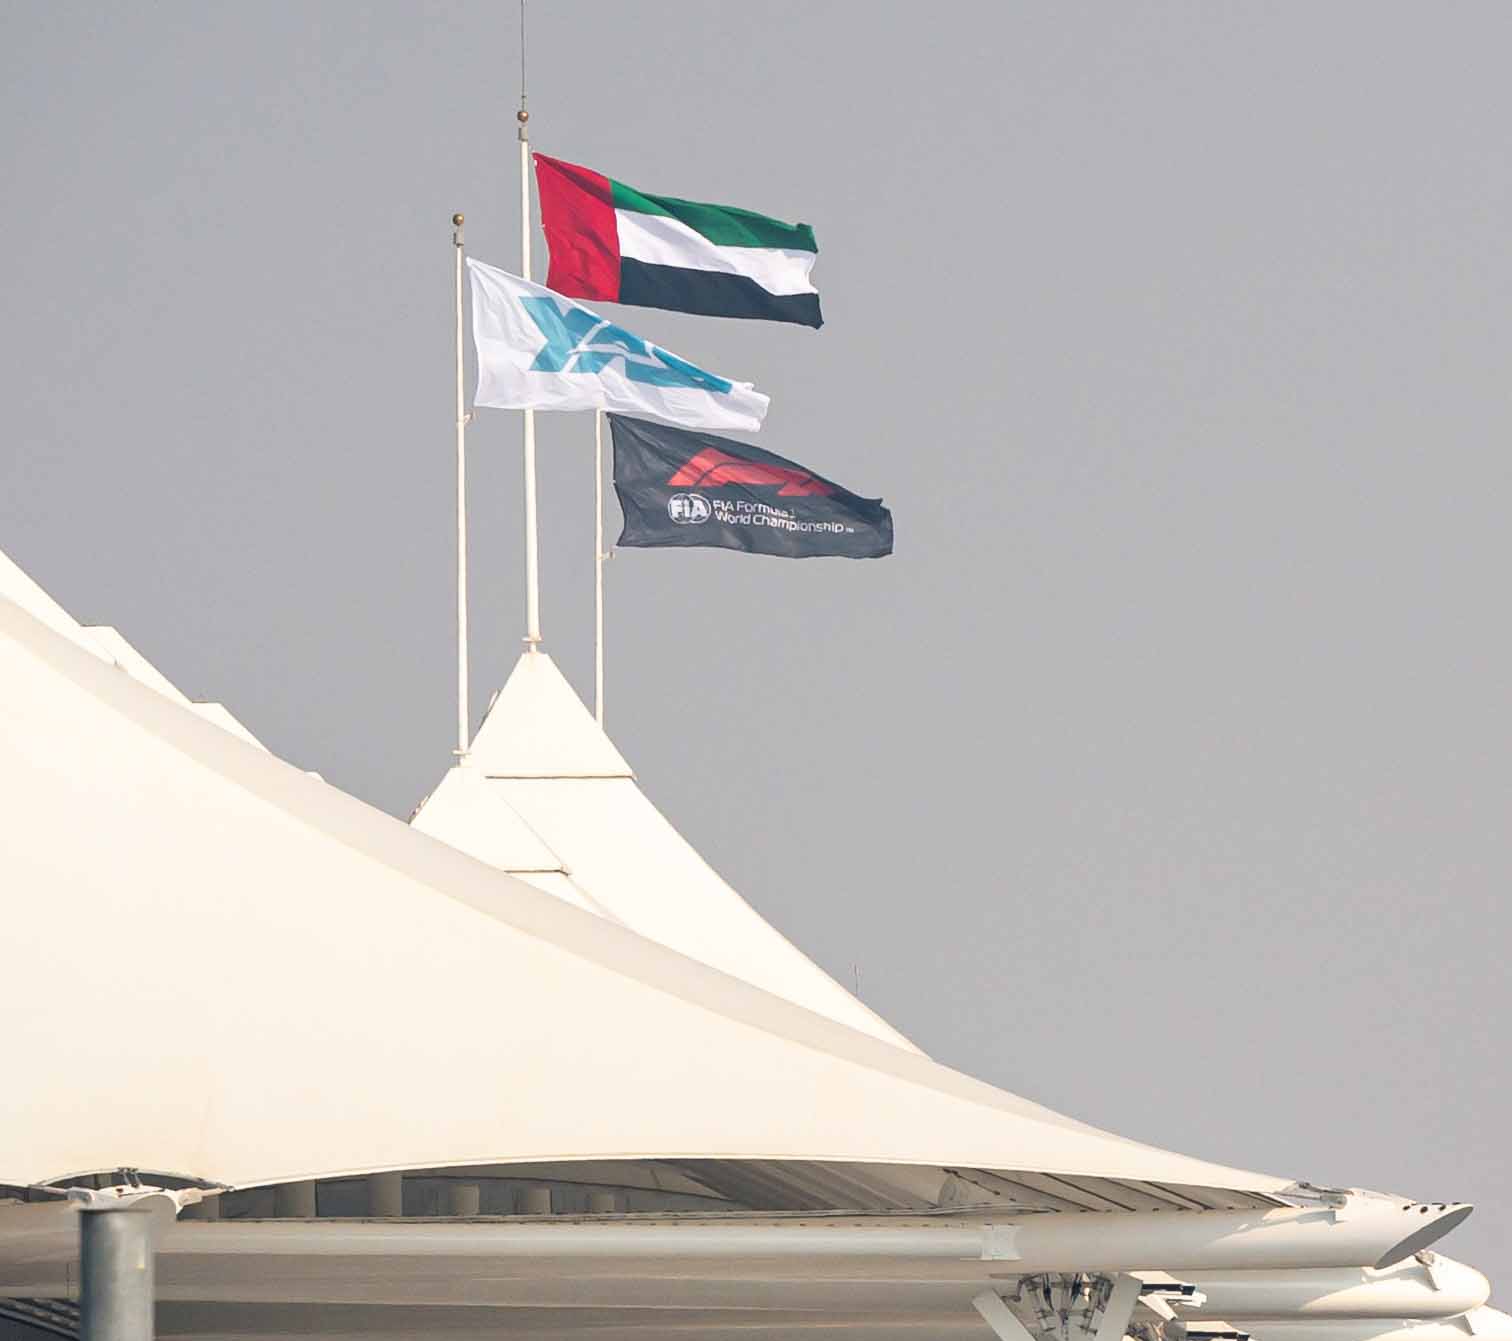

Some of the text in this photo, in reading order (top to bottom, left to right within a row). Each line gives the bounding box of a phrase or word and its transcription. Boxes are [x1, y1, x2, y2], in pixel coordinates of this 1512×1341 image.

[669, 494, 709, 522] FIA
[712, 499, 734, 512] FIA
[715, 510, 844, 533] World Championship
